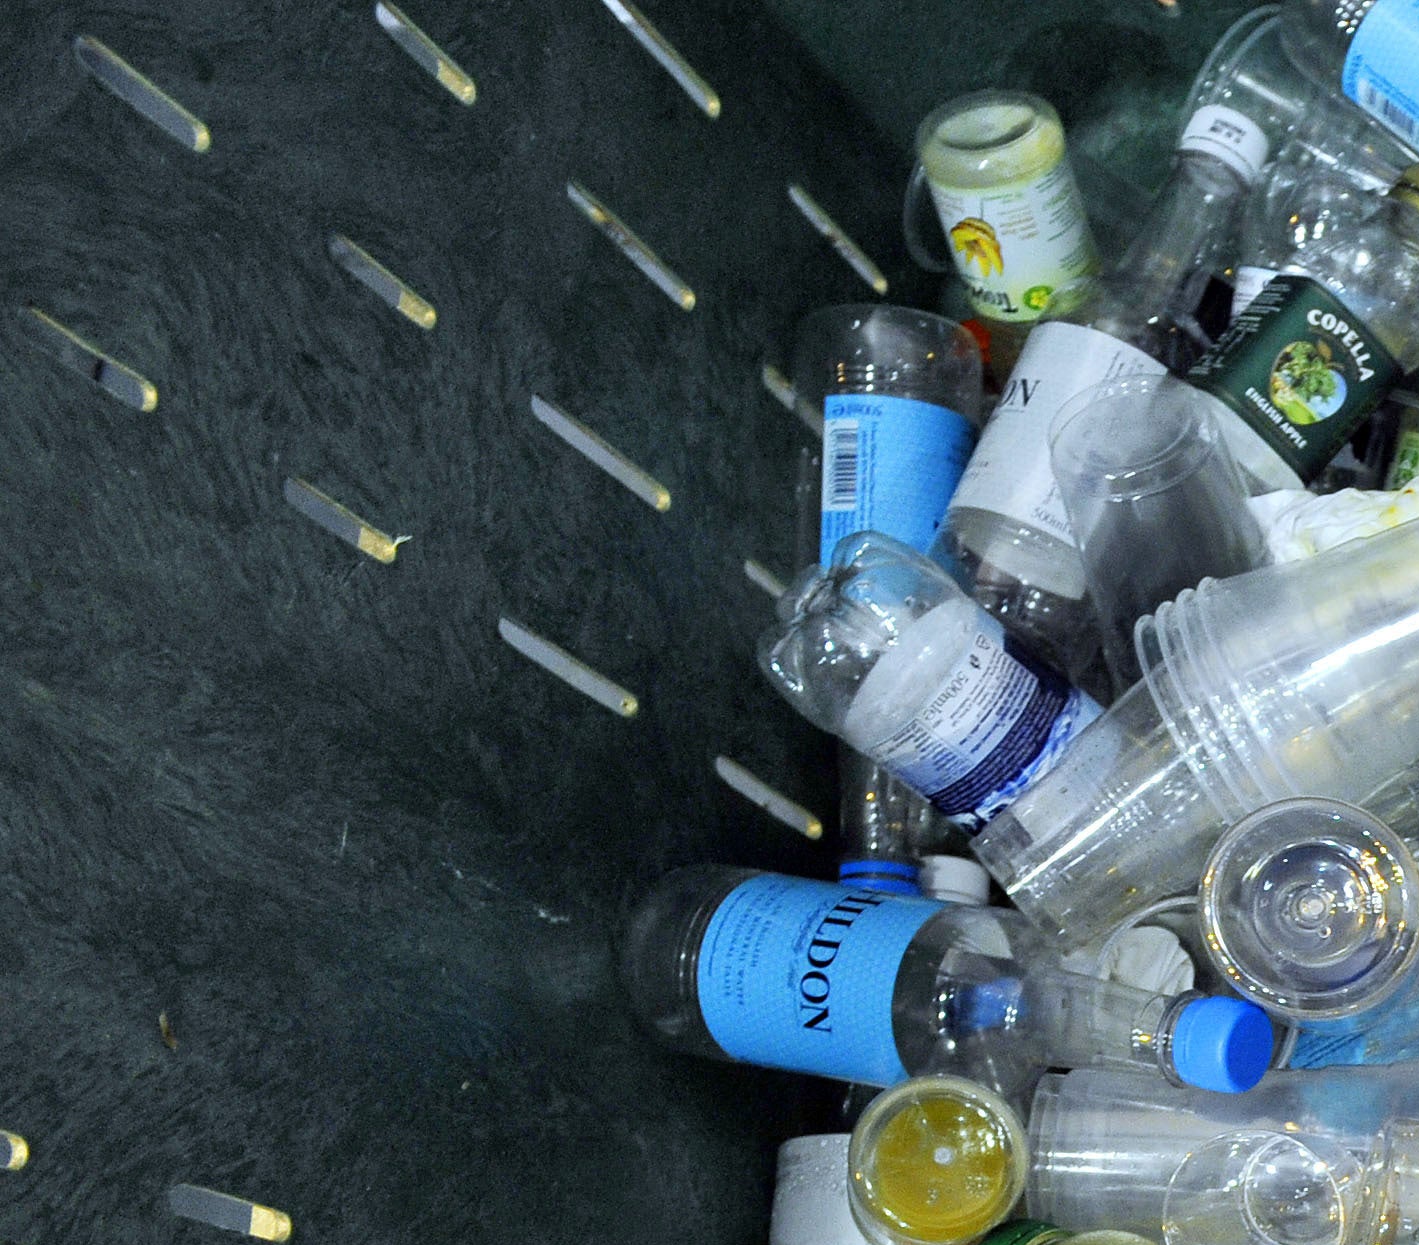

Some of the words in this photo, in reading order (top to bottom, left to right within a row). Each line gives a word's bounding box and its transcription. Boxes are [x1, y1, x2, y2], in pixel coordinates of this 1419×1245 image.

[1306, 309, 1375, 382] COPELLA
[1245, 387, 1283, 425] ENGLISH
[1279, 419, 1308, 449] APPLE
[800, 889, 886, 1033] HILDON
